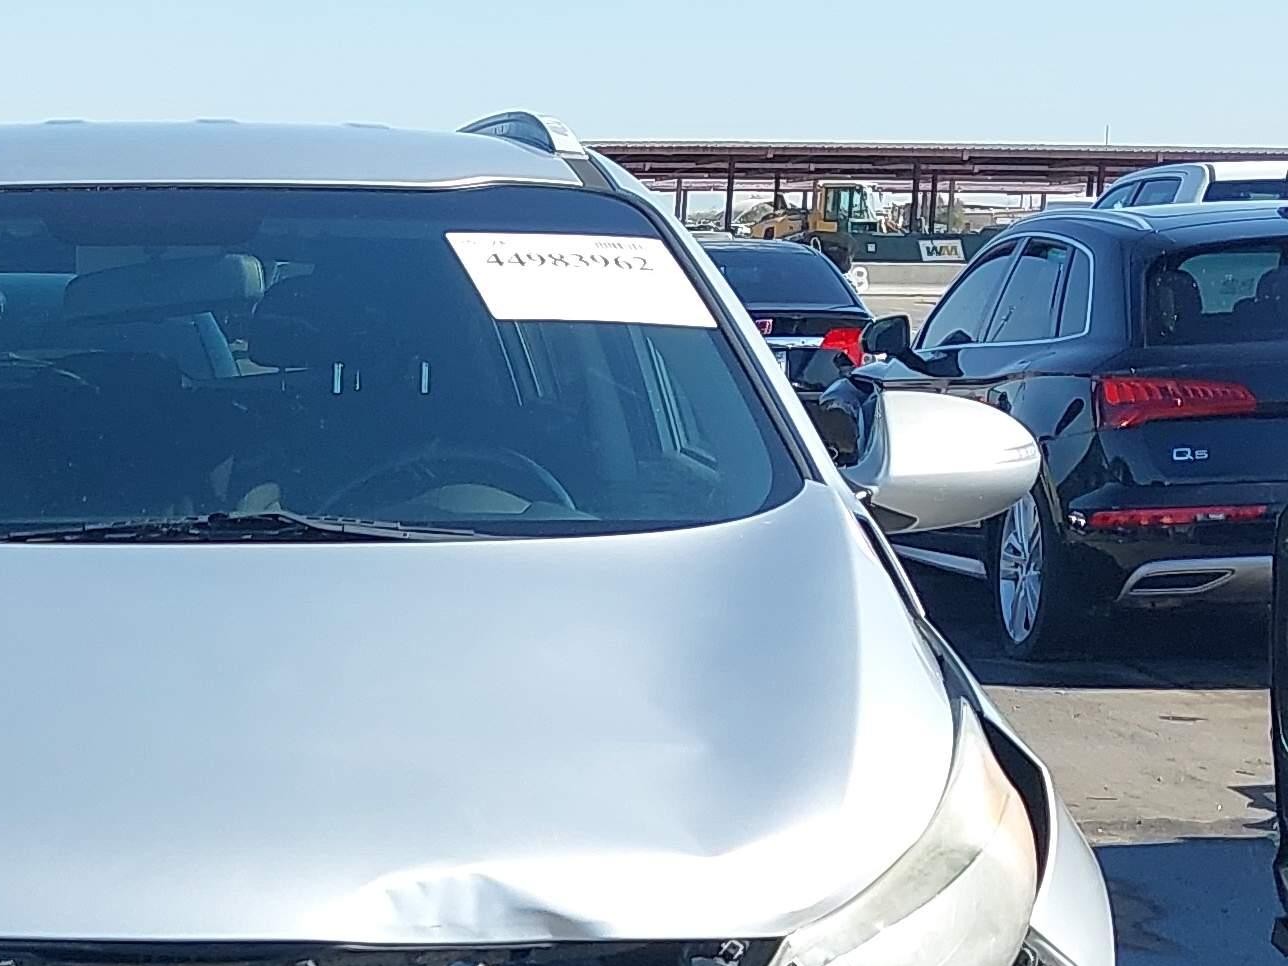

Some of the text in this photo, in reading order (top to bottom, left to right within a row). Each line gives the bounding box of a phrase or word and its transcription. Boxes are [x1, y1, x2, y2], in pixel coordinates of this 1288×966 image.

[925, 245, 959, 257] WM
[486, 252, 654, 271] 44983962
[1173, 447, 1209, 461] Q5
